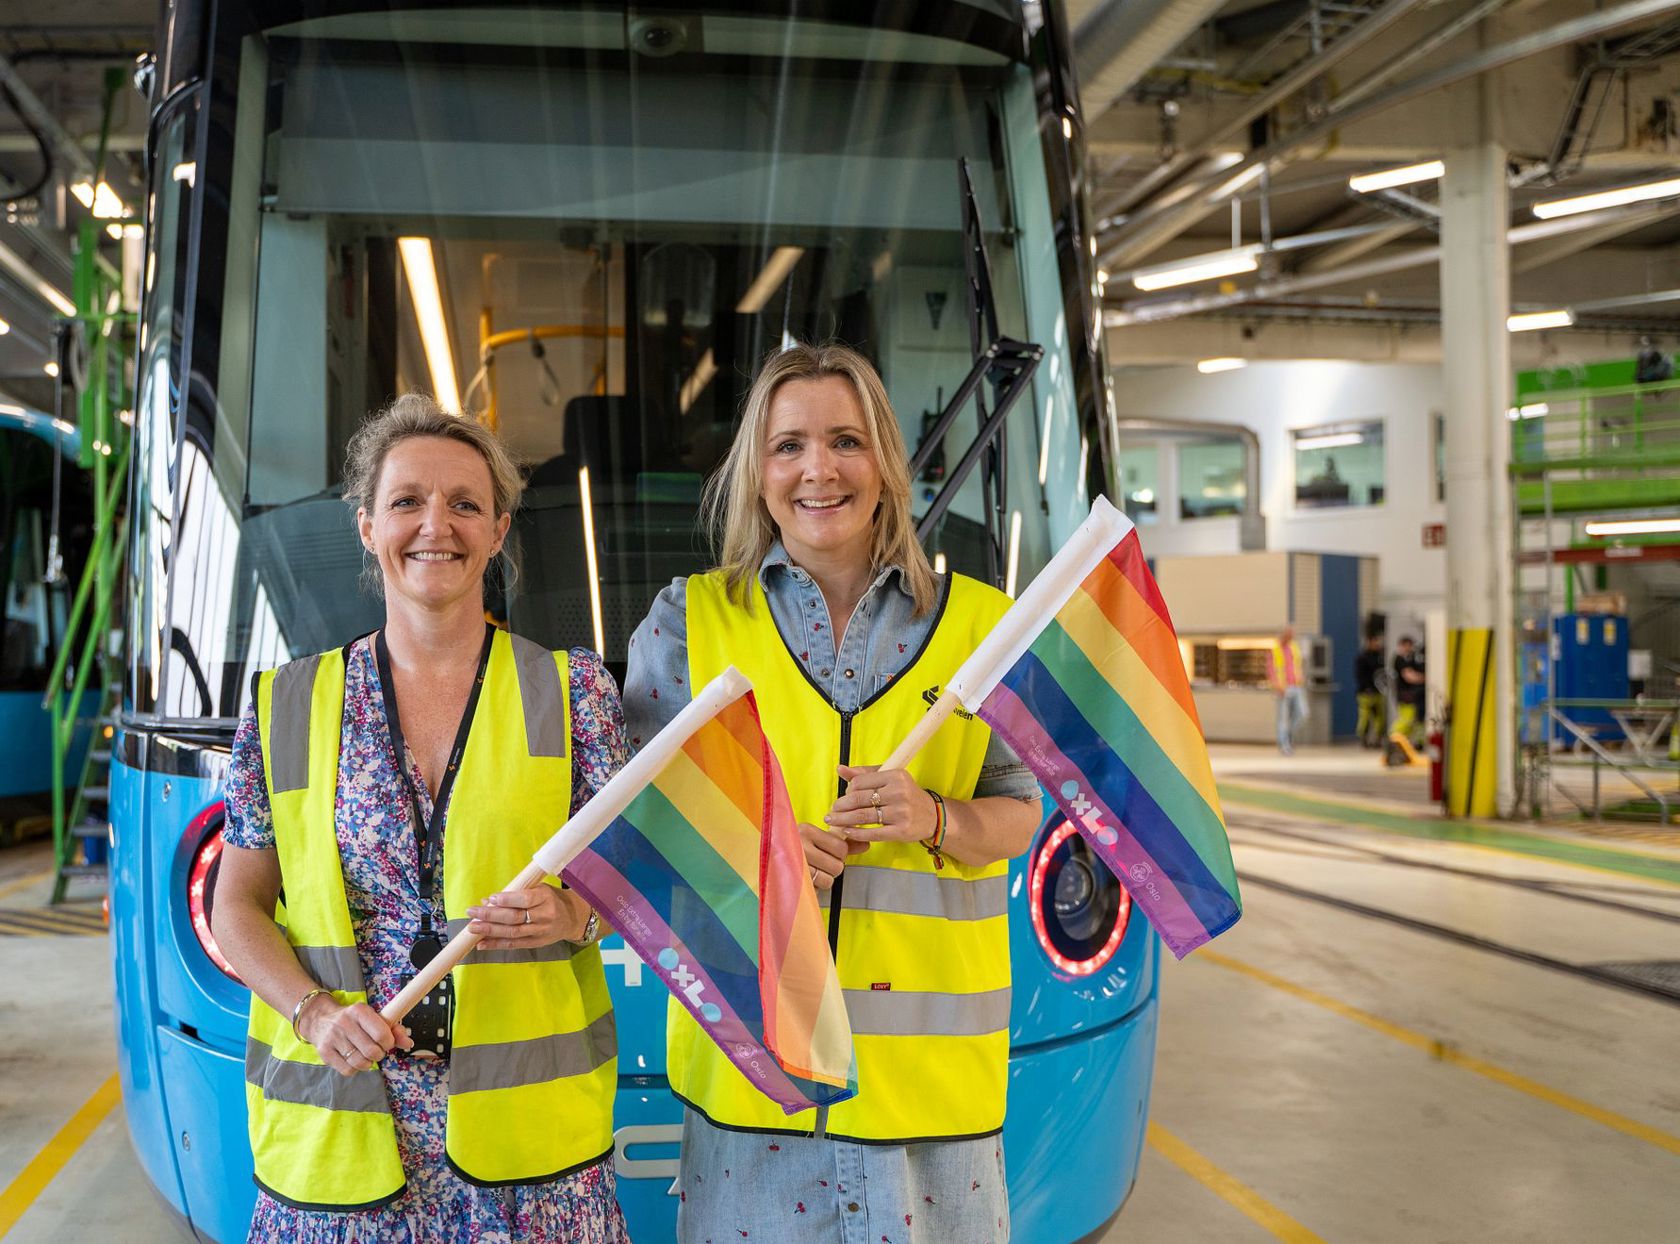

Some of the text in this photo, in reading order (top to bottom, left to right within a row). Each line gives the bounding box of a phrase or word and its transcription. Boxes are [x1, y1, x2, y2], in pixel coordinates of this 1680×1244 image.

[1146, 881, 1161, 901] Oslo
[616, 895, 629, 909] Oslo
[626, 905, 640, 922] Extra
[751, 1060, 767, 1079] Oslo
